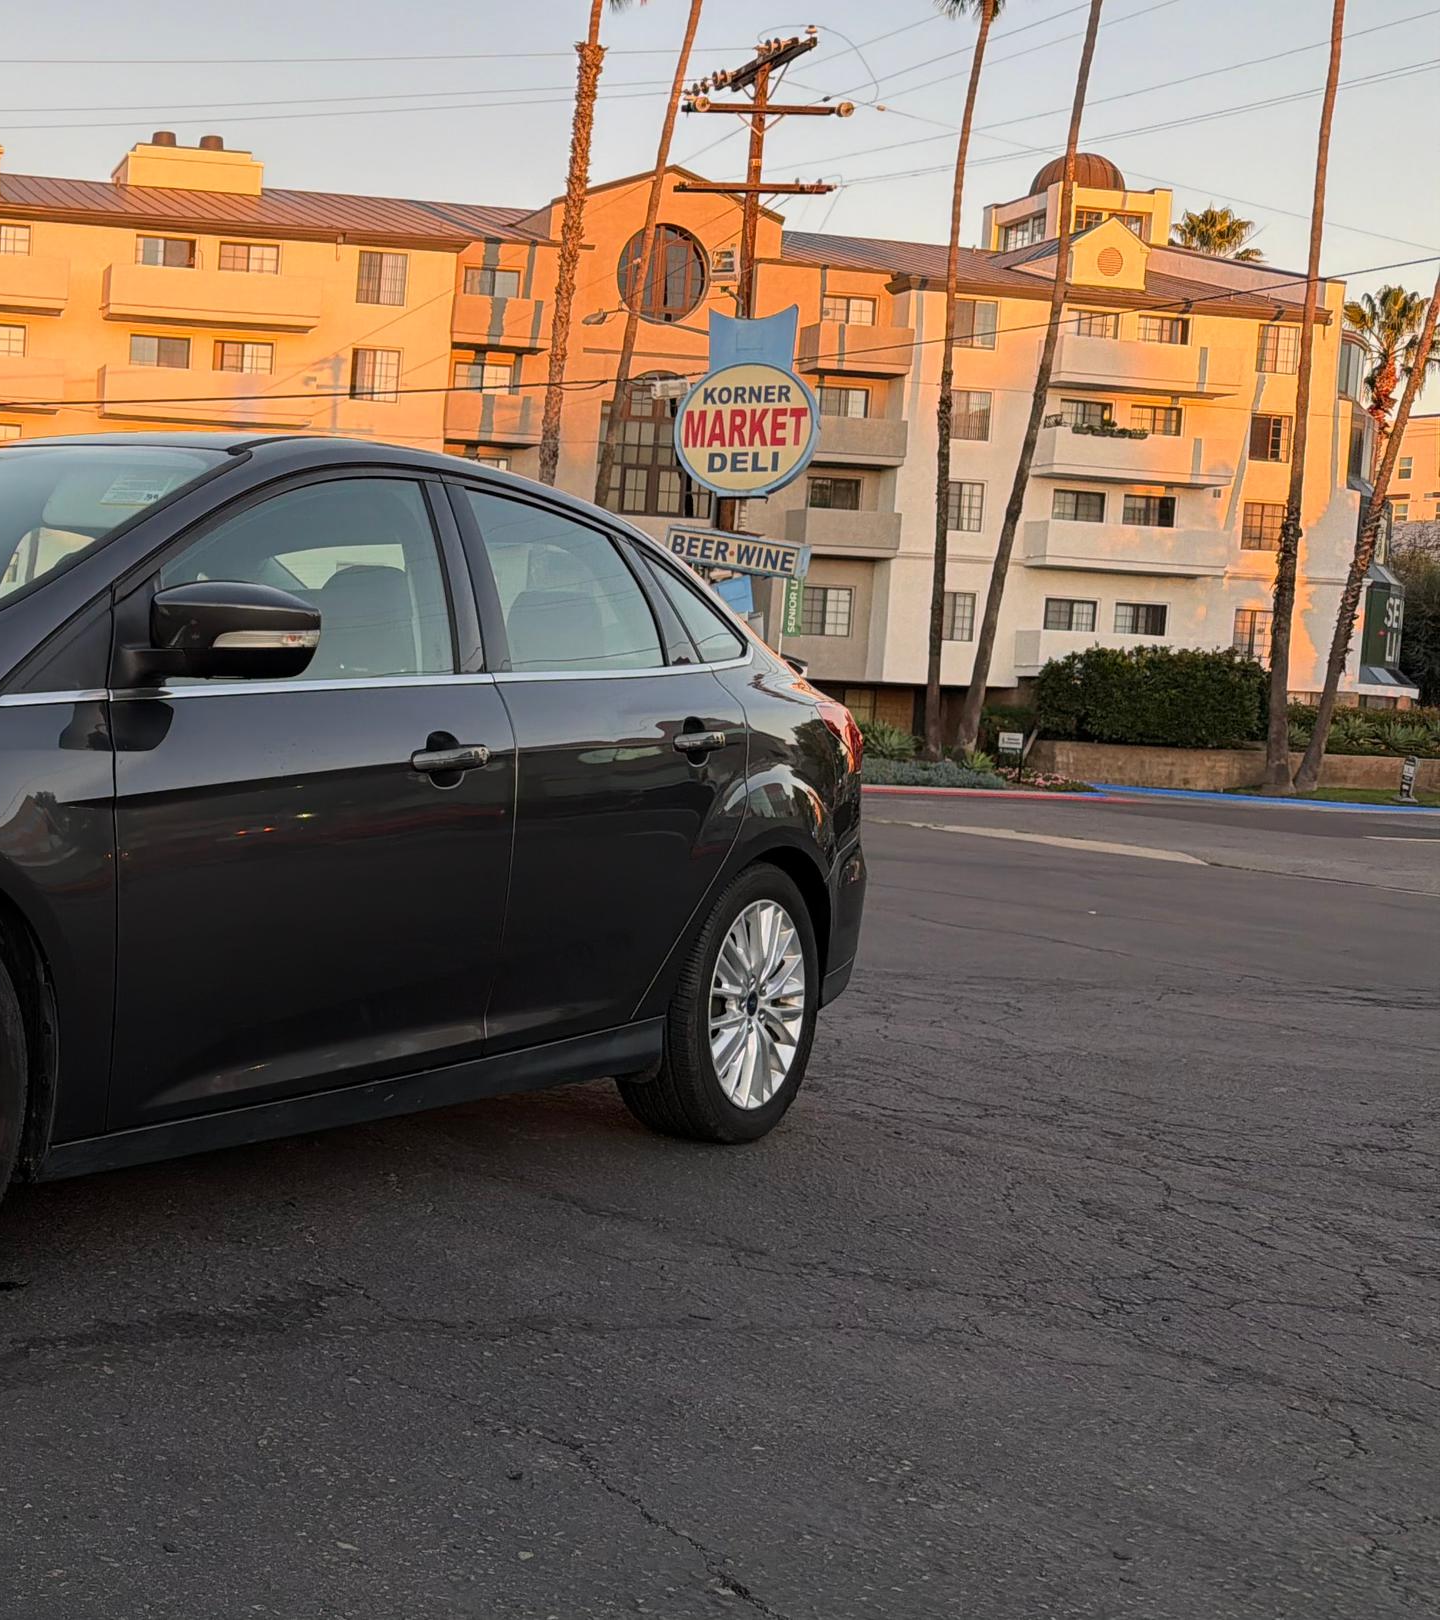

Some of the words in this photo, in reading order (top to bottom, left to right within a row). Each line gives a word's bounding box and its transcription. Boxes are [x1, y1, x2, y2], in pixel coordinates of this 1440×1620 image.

[703, 385, 792, 404] KORNER
[683, 407, 809, 448] MARKET
[707, 451, 780, 473] DELI
[787, 592, 798, 633] SENIOR
